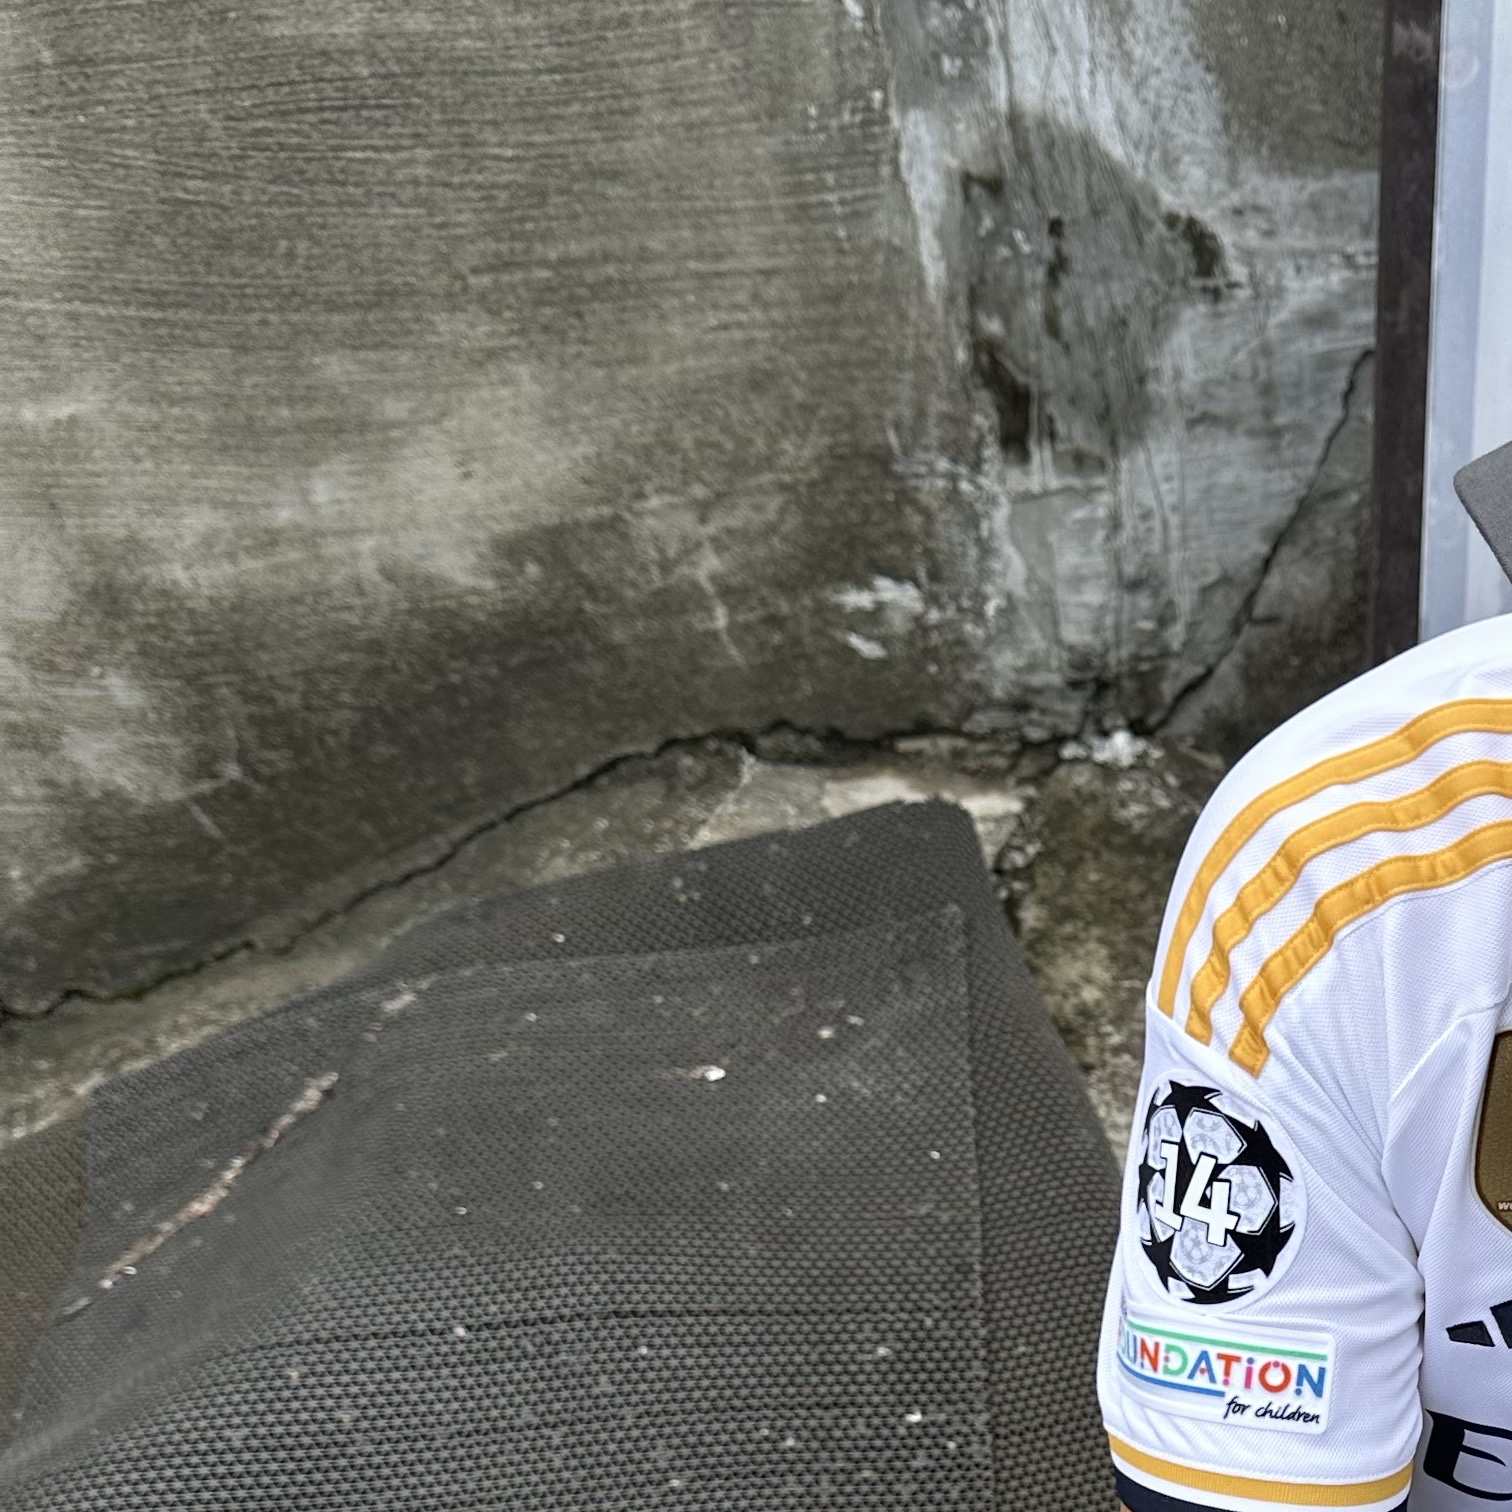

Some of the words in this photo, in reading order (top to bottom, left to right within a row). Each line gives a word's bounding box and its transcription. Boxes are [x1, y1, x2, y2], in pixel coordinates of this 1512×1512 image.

[1154, 1139, 1240, 1247] 14
[1223, 1395, 1252, 1419] for
[1255, 1402, 1320, 1424] children
